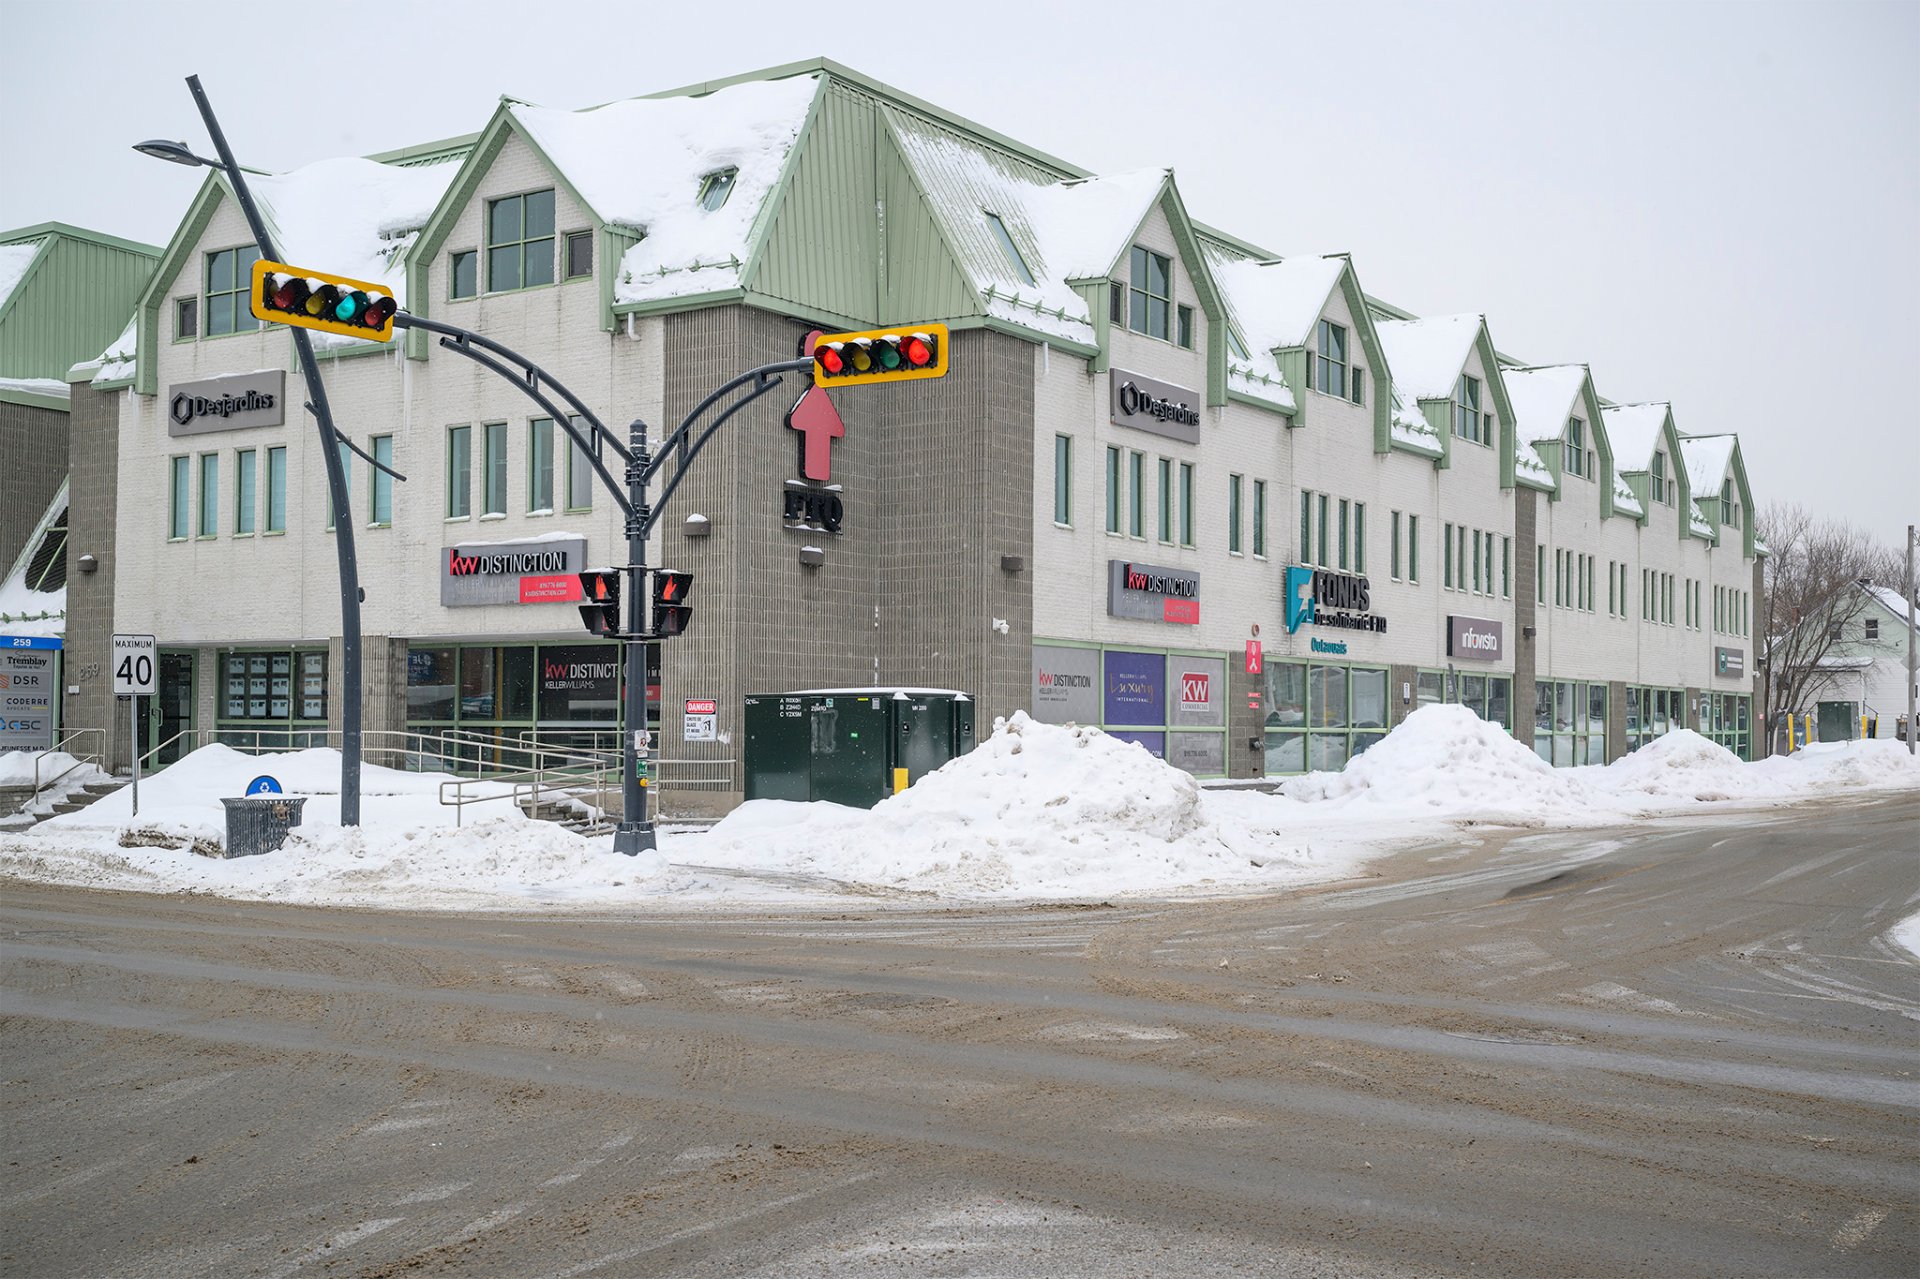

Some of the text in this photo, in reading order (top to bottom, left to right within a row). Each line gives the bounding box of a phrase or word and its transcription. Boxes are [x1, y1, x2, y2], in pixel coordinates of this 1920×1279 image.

[195, 390, 274, 418] Desjardins
[1140, 391, 1200, 426] Desjardins
[783, 490, 844, 532] FTQ
[449, 549, 567, 576] kw DISTINCTION
[1126, 563, 1197, 597] kw DISTINCTION
[1314, 571, 1370, 611] FONDS
[13, 638, 32, 647] 259
[115, 640, 152, 648] MAXIMUM
[1311, 637, 1348, 655] Outaouais
[7, 656, 47, 667] Tremblay
[116, 655, 152, 685] 40
[545, 658, 569, 679] kw
[570, 663, 628, 679] DISTINCT
[13, 675, 39, 685] DSR
[1039, 668, 1091, 688] kw DISTINCTION
[1109, 672, 1154, 704] Luxury
[1182, 679, 1208, 701] KW
[6, 697, 48, 705] CODERRE
[687, 703, 714, 711] DANGER
[8, 720, 41, 730] GSC
